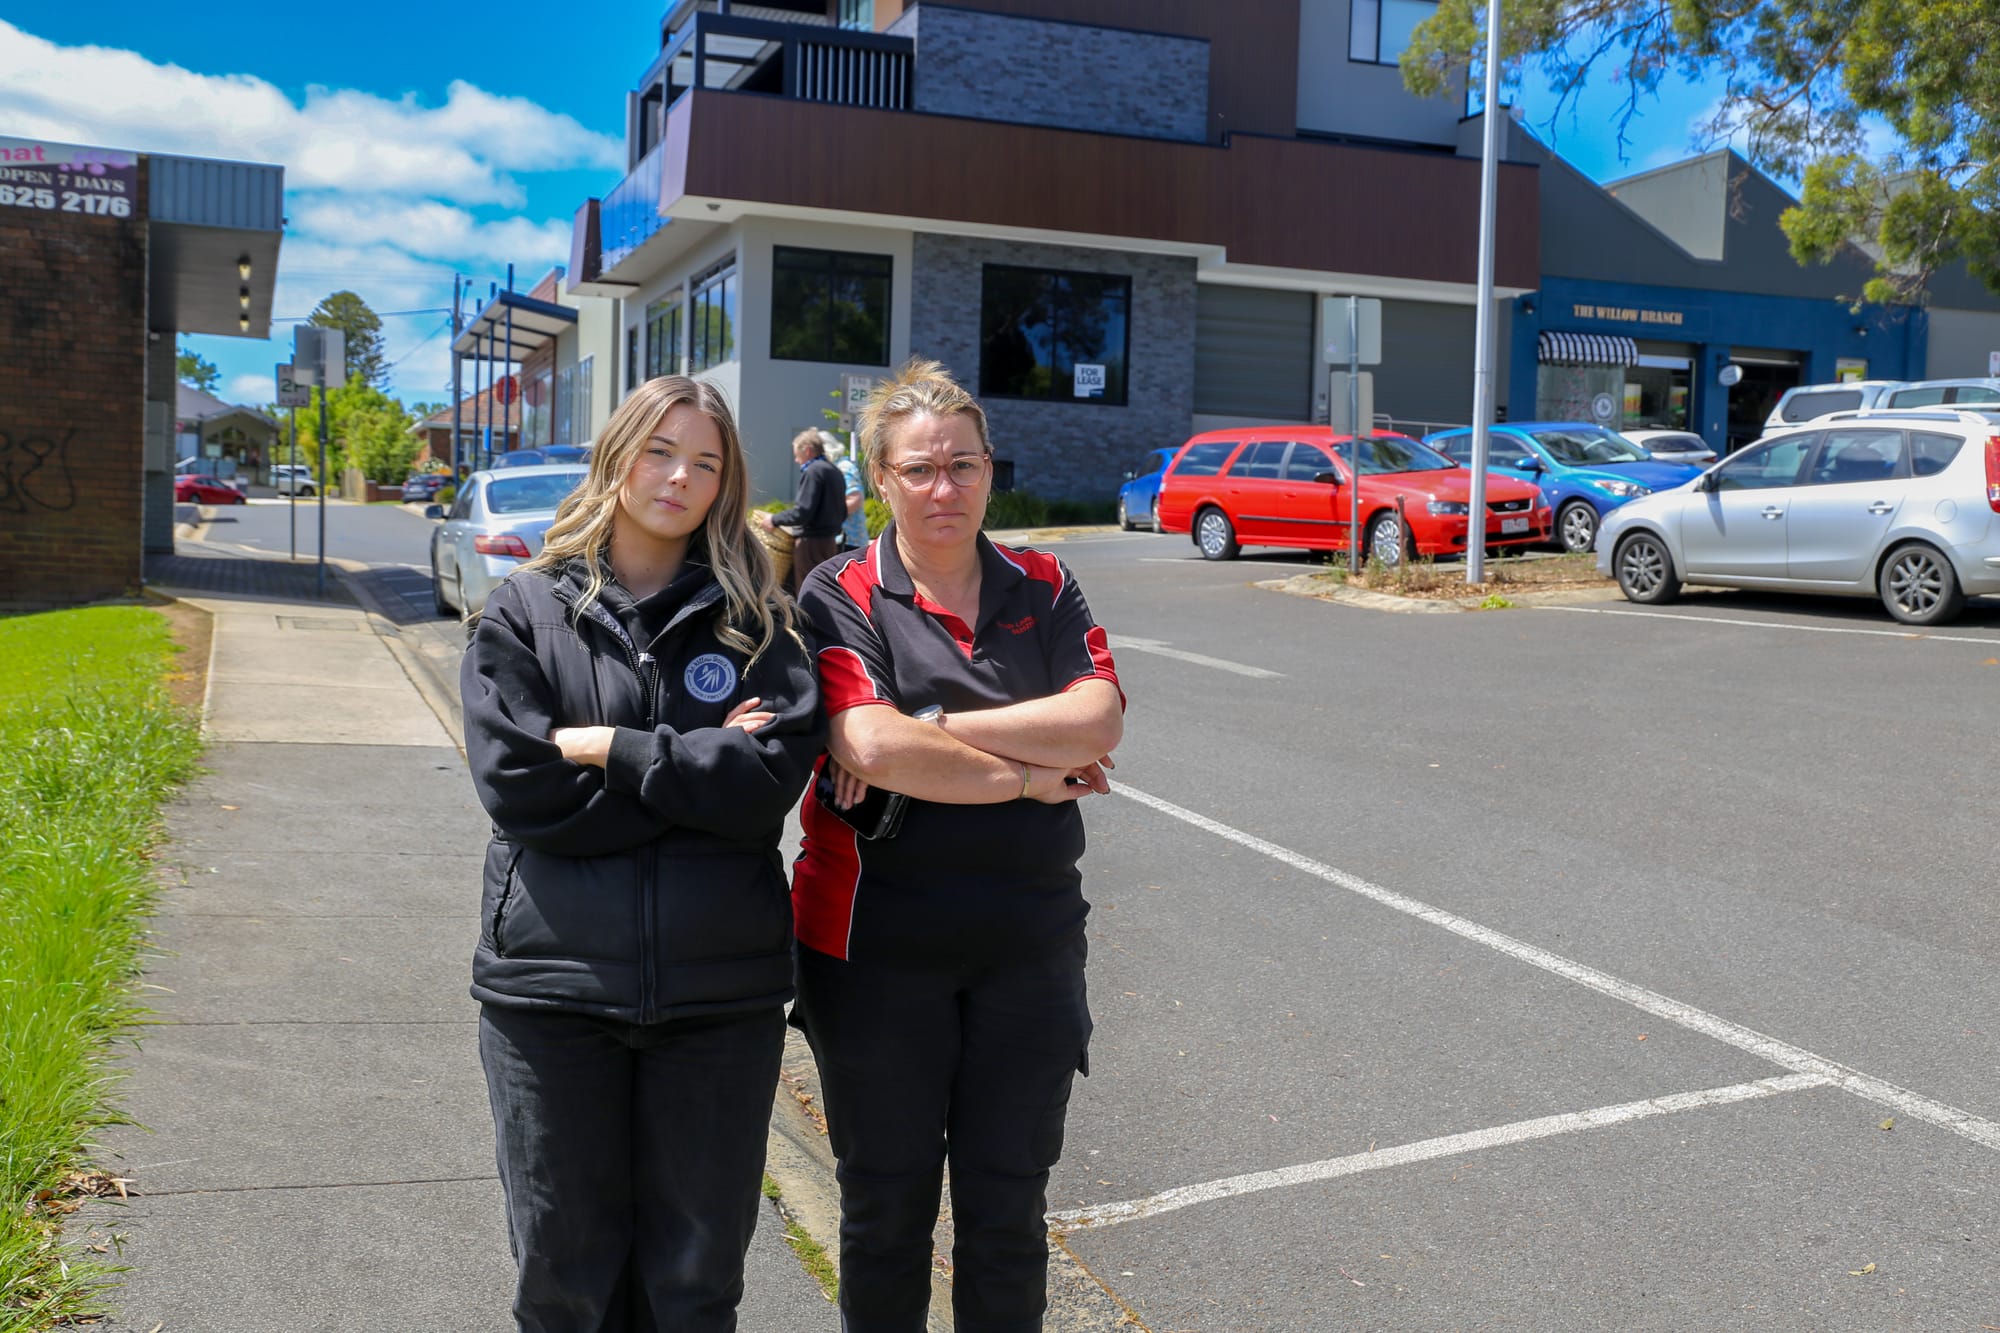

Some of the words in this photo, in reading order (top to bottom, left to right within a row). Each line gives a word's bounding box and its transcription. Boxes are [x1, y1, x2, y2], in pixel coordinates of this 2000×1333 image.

[0, 168, 53, 185] OPEN
[58, 174, 69, 187] 7
[75, 176, 125, 193] DAYS
[0, 184, 56, 210] 625
[61, 191, 131, 217] 2176
[1574, 304, 1595, 318] THE
[1596, 306, 1639, 321] WILLOW
[1640, 309, 1683, 325] BRANCH
[1077, 375, 1102, 385] LEASE
[1081, 367, 1098, 376] FOR
